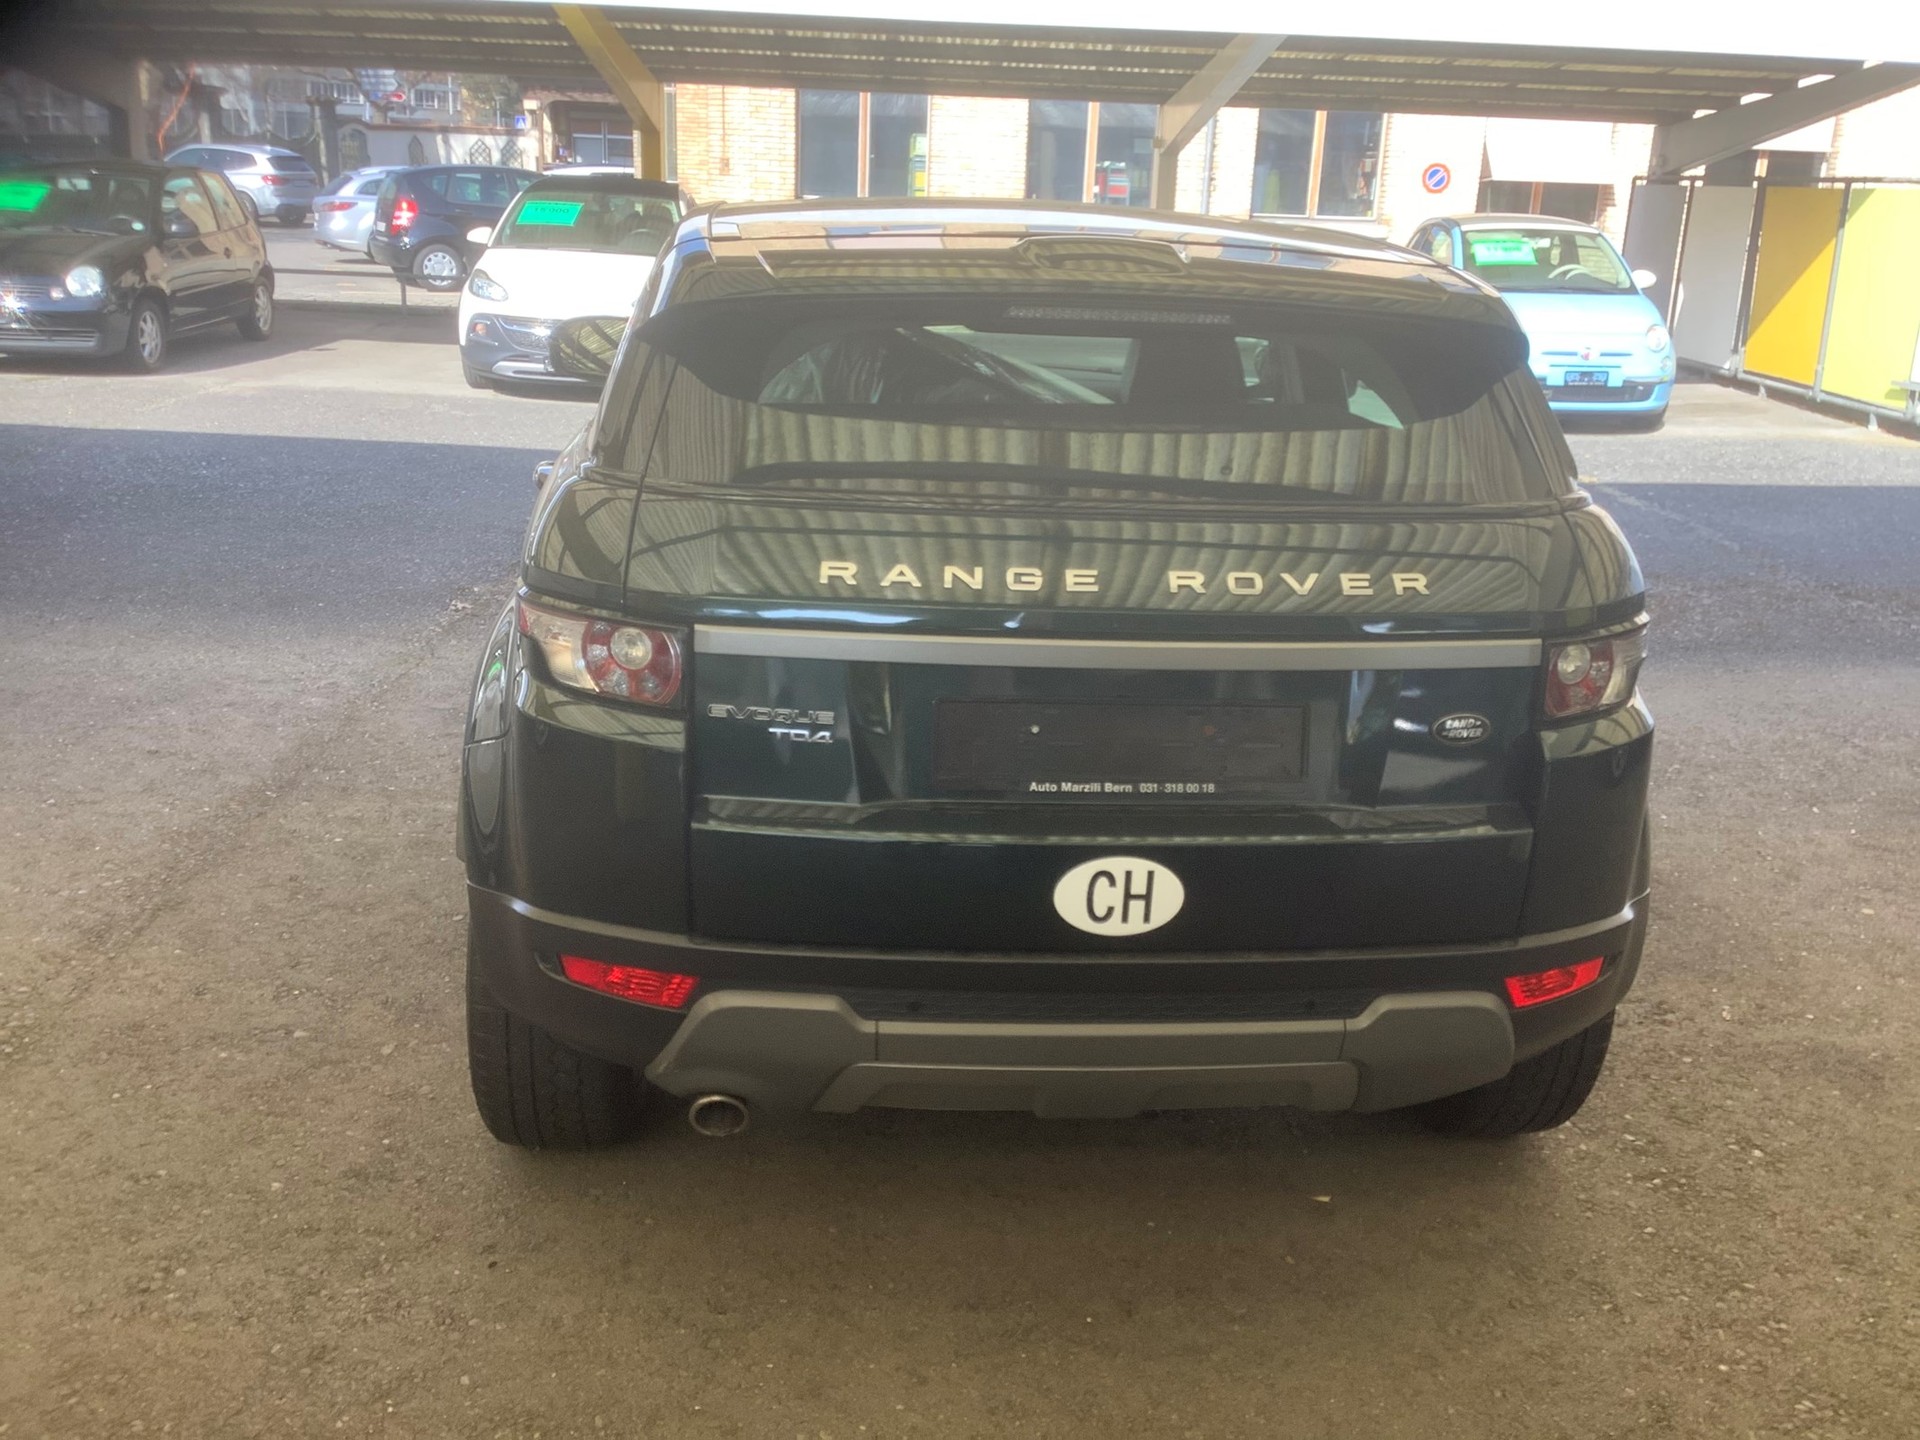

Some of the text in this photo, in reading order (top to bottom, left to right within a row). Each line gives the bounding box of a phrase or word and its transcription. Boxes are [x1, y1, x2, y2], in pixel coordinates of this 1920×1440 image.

[819, 561, 1430, 595] RANGE ROVER
[707, 703, 835, 725] EVOQUE
[1446, 719, 1475, 728] LAND
[768, 727, 833, 743] TD4
[1448, 728, 1483, 738] ROVER
[1029, 782, 1058, 792] Auto
[1061, 782, 1101, 793] Marzili
[1104, 782, 1133, 793] Bern
[1186, 783, 1200, 793] 00
[1201, 783, 1216, 793] 18
[1086, 870, 1155, 924] CH
